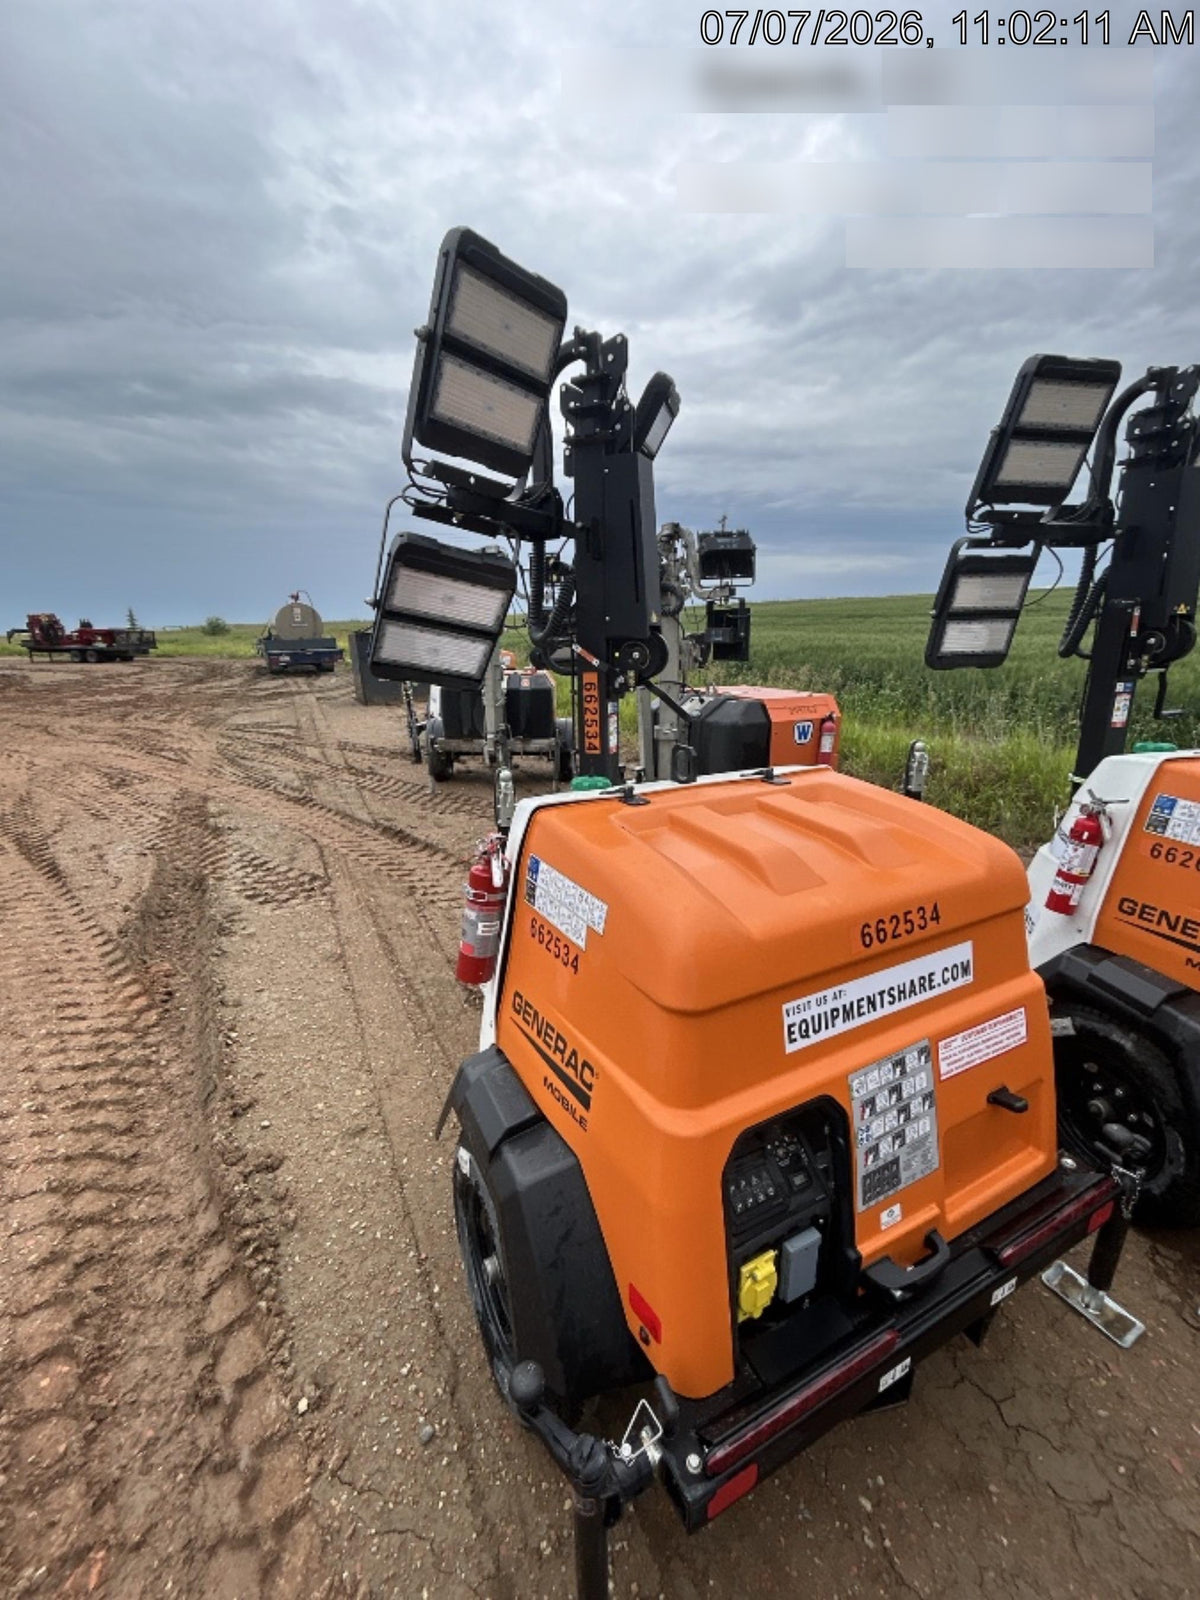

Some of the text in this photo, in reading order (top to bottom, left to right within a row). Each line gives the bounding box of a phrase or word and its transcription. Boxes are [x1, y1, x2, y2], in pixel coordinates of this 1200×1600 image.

[584, 682, 600, 751] 662534
[530, 916, 580, 976] 662534
[860, 901, 942, 949] 662534
[785, 1000, 812, 1018] VISIT
[815, 994, 828, 1007] US
[787, 958, 972, 1045] EQUIPMENTSHARE.COM
[511, 990, 596, 1093] GENERAC
[543, 1075, 588, 1133] MOBILE
